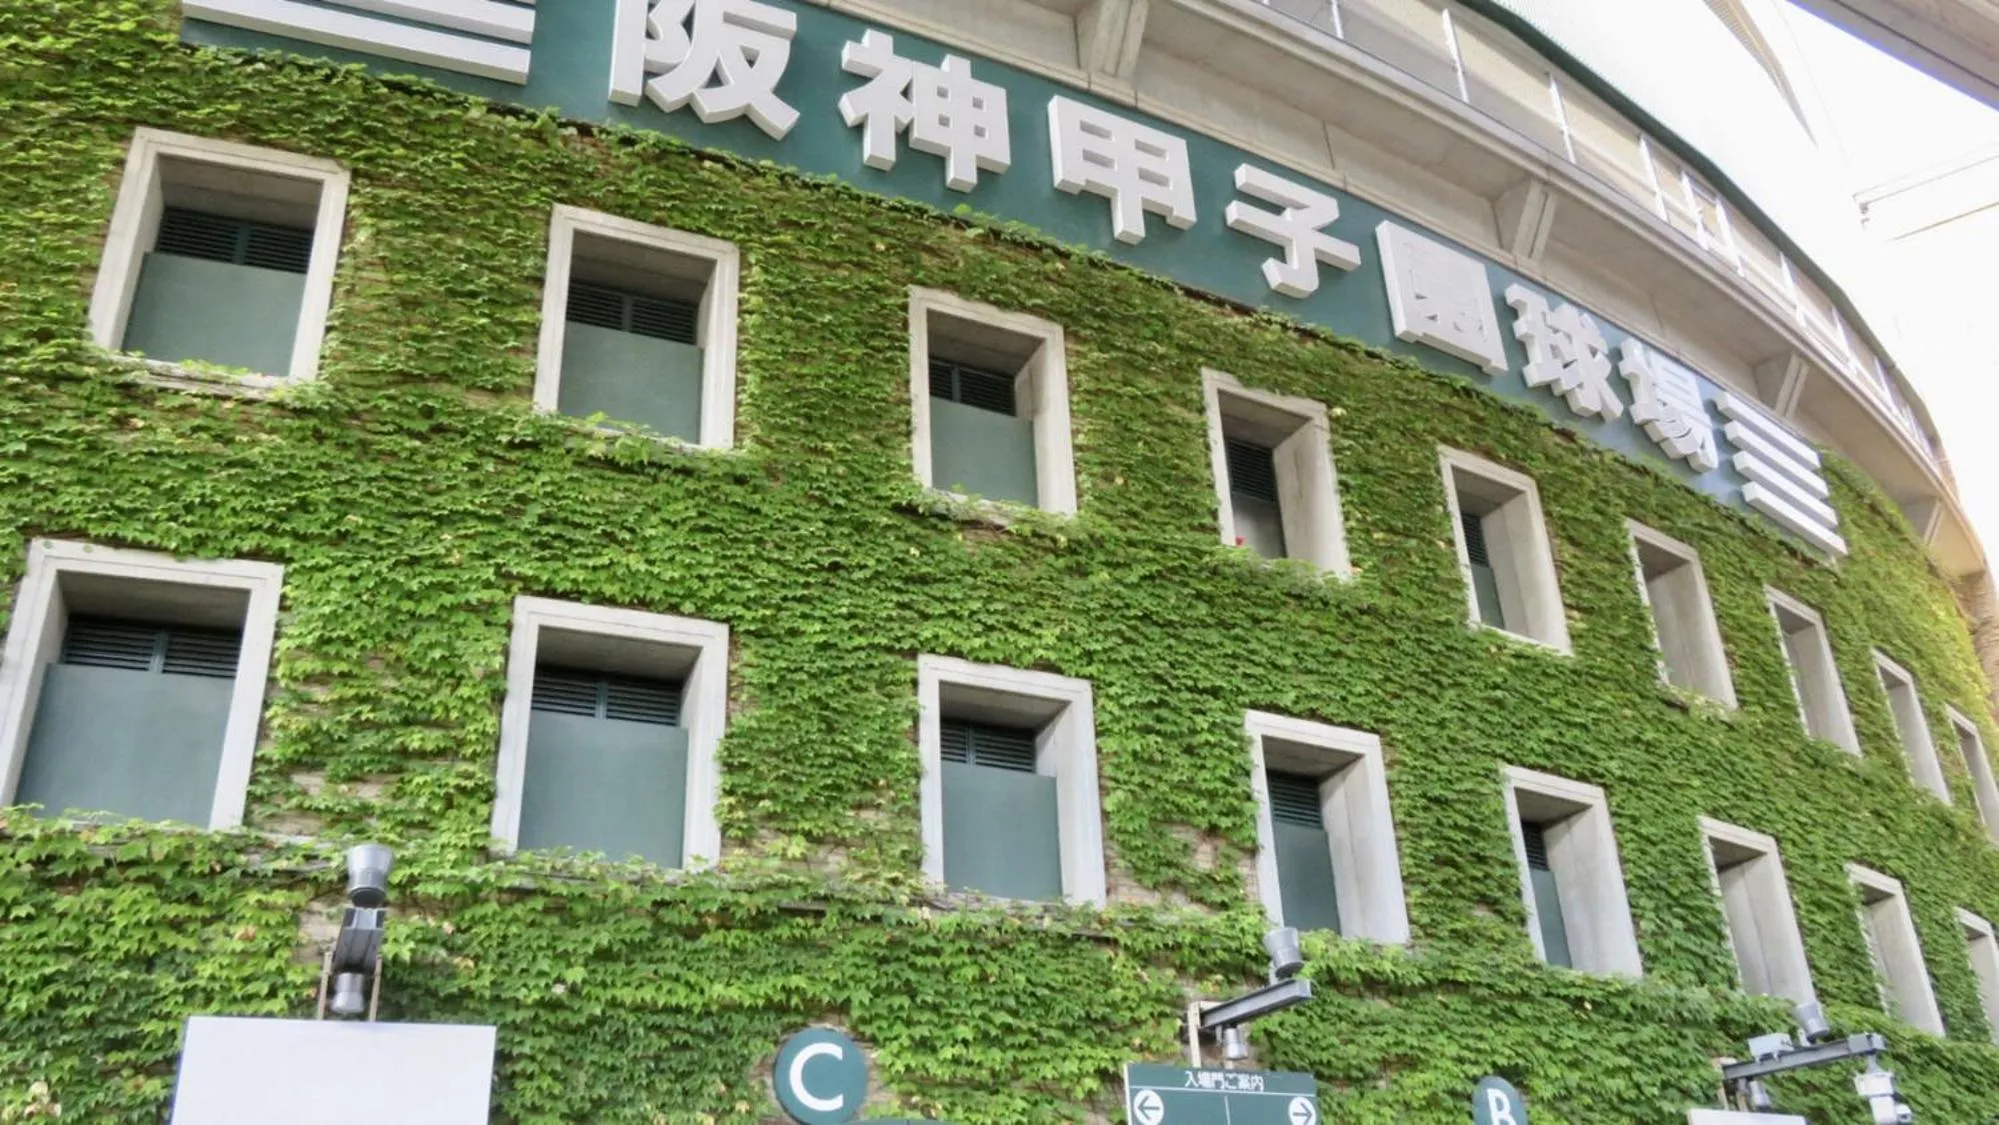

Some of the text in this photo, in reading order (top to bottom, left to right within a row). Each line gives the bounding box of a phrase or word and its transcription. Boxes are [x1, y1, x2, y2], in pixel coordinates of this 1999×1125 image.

[609, 0, 1719, 472] 阪神甲子園球場
[789, 1042, 844, 1111] C
[1486, 1088, 1518, 1125] B
